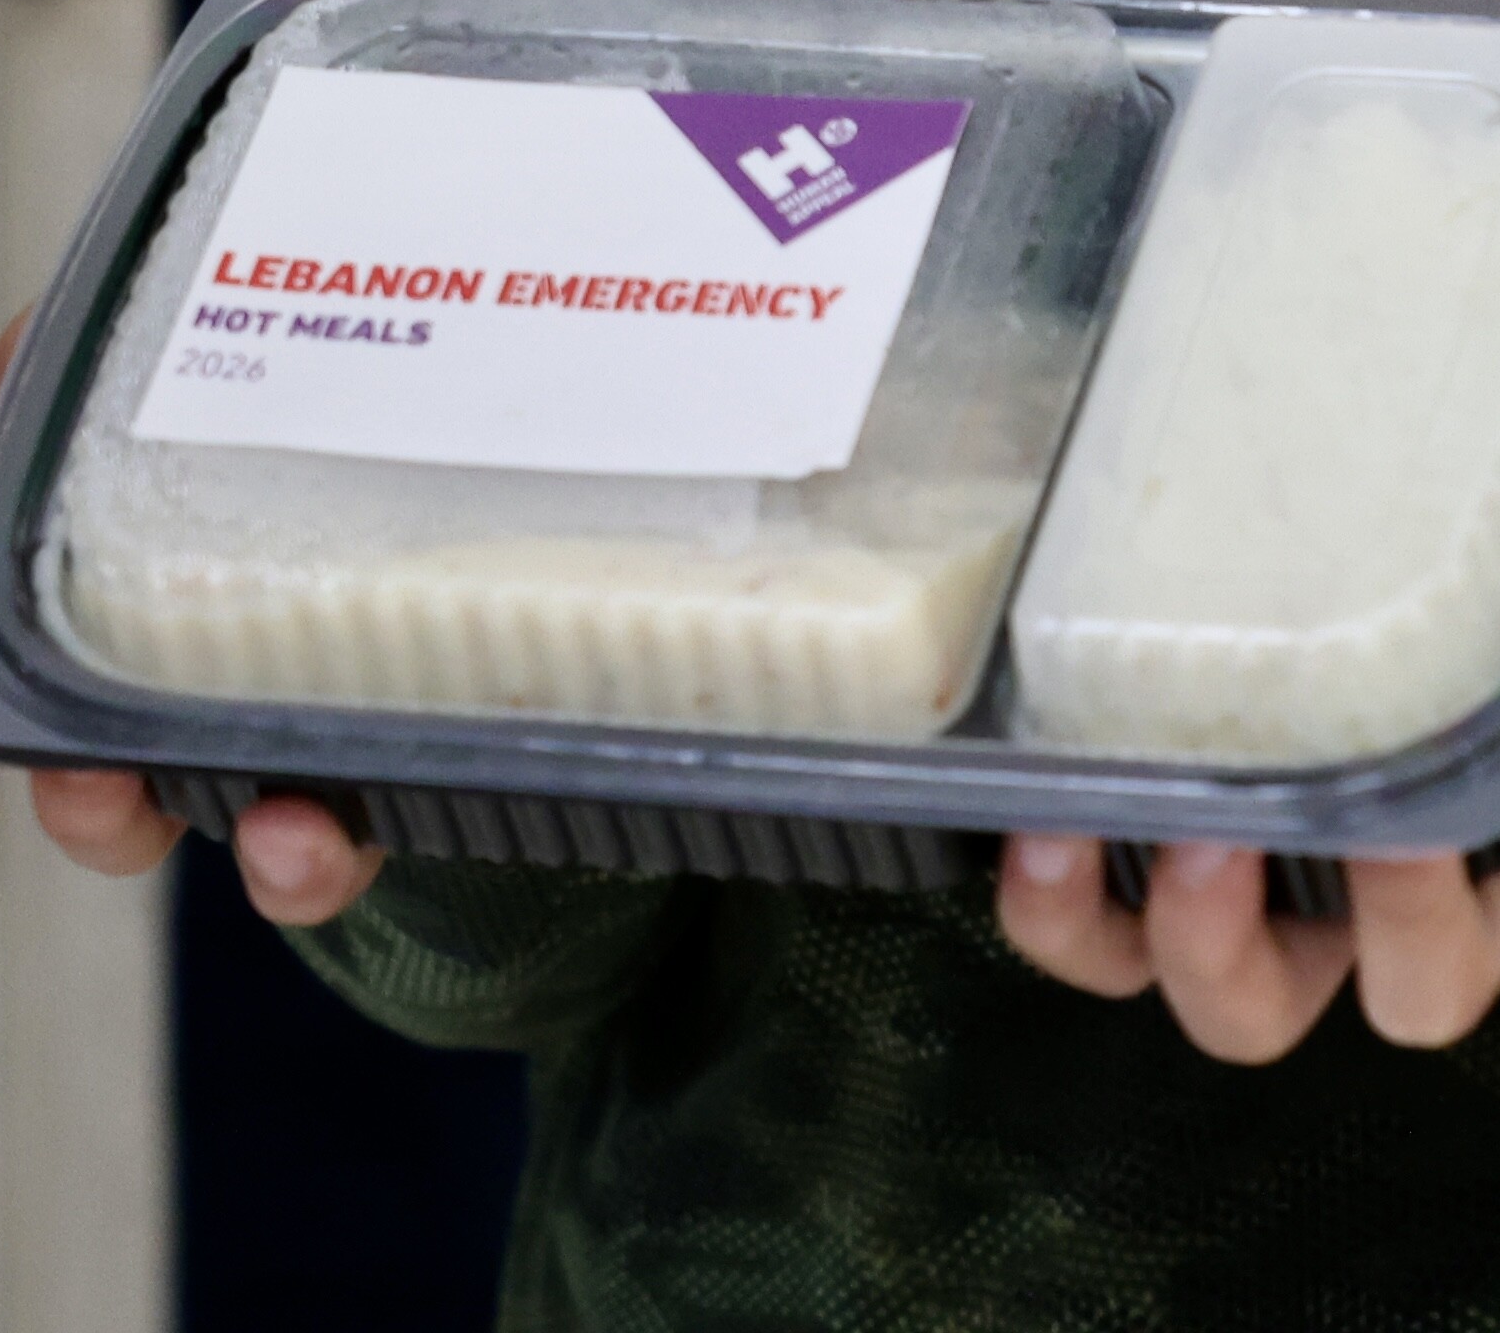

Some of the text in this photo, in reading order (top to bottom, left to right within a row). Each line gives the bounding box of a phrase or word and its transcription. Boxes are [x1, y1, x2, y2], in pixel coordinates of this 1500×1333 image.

[736, 123, 836, 201] H
[213, 250, 843, 321] LEBANON EMERGENCY
[193, 304, 433, 346] HOT MEALS
[175, 346, 267, 382] 2026
